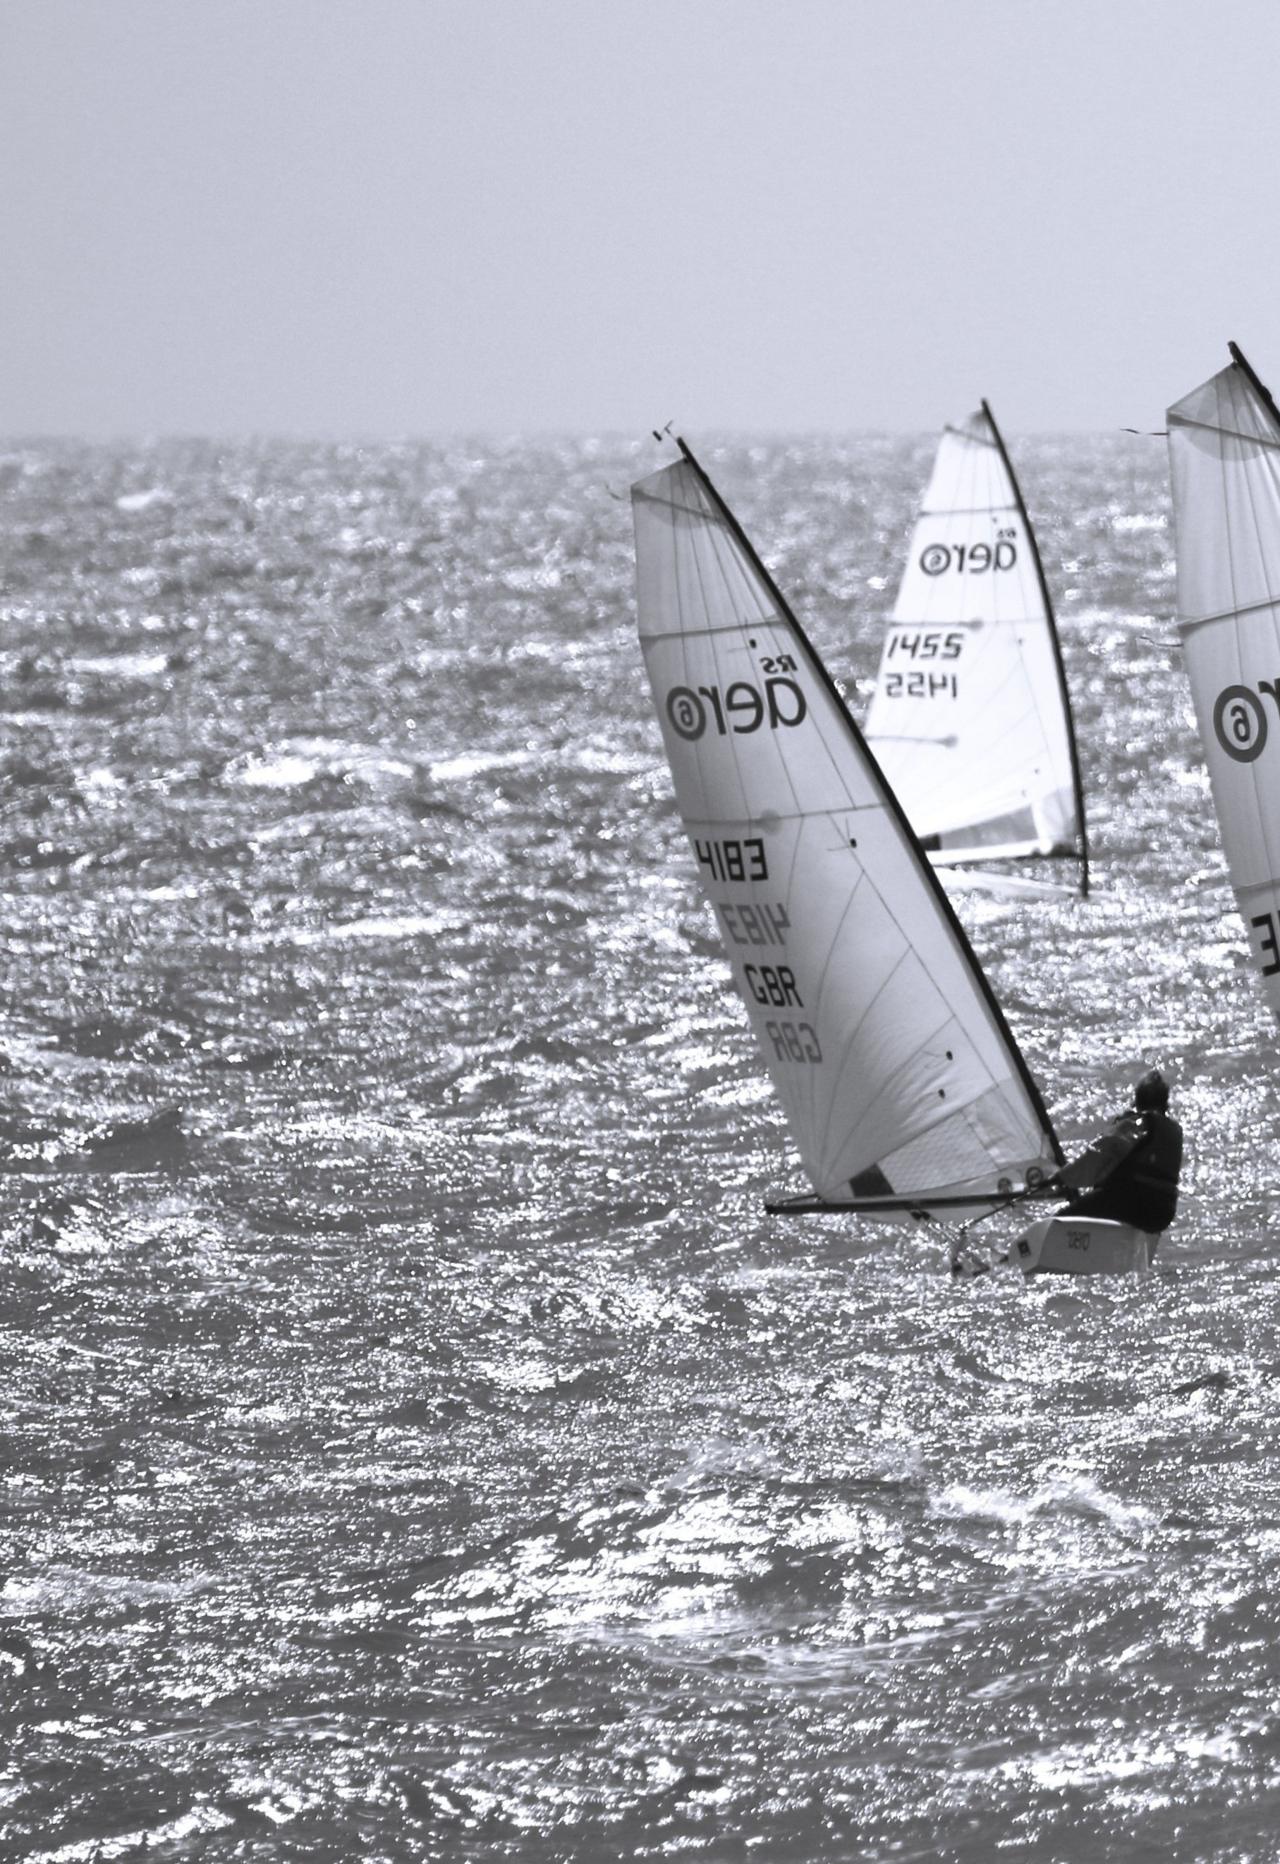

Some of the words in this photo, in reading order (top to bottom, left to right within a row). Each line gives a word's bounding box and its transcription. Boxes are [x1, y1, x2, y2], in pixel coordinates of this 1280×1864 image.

[888, 633, 965, 659] 1455
[694, 838, 769, 882] 4183
[743, 963, 804, 1008] GBR
